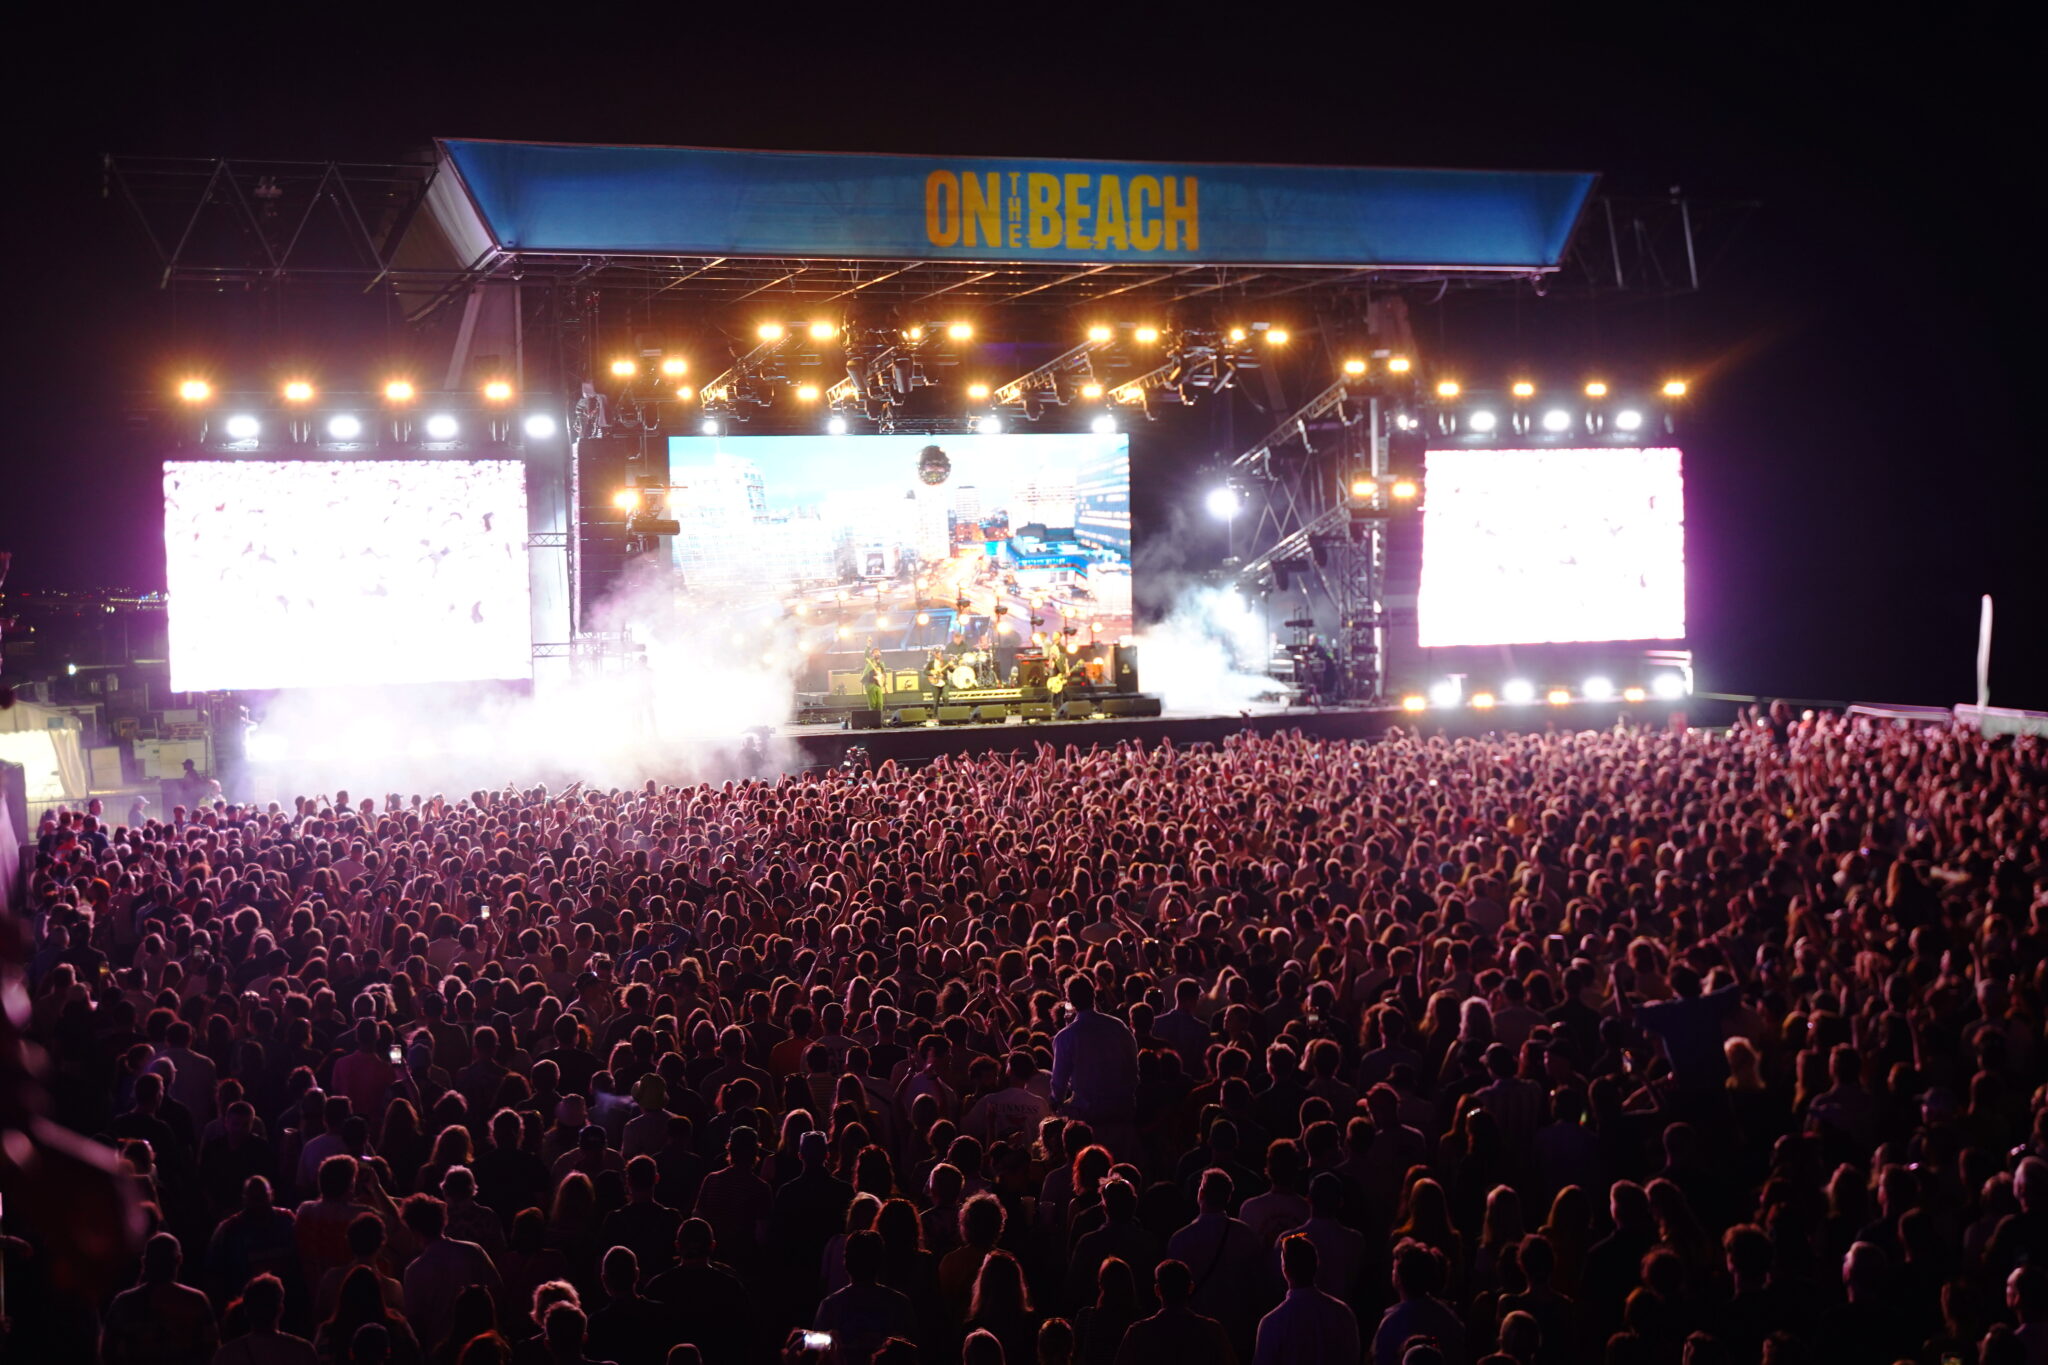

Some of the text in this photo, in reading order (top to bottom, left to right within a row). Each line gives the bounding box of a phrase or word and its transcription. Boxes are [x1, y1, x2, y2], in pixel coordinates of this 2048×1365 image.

[926, 170, 1199, 251] ON THE BEACH
